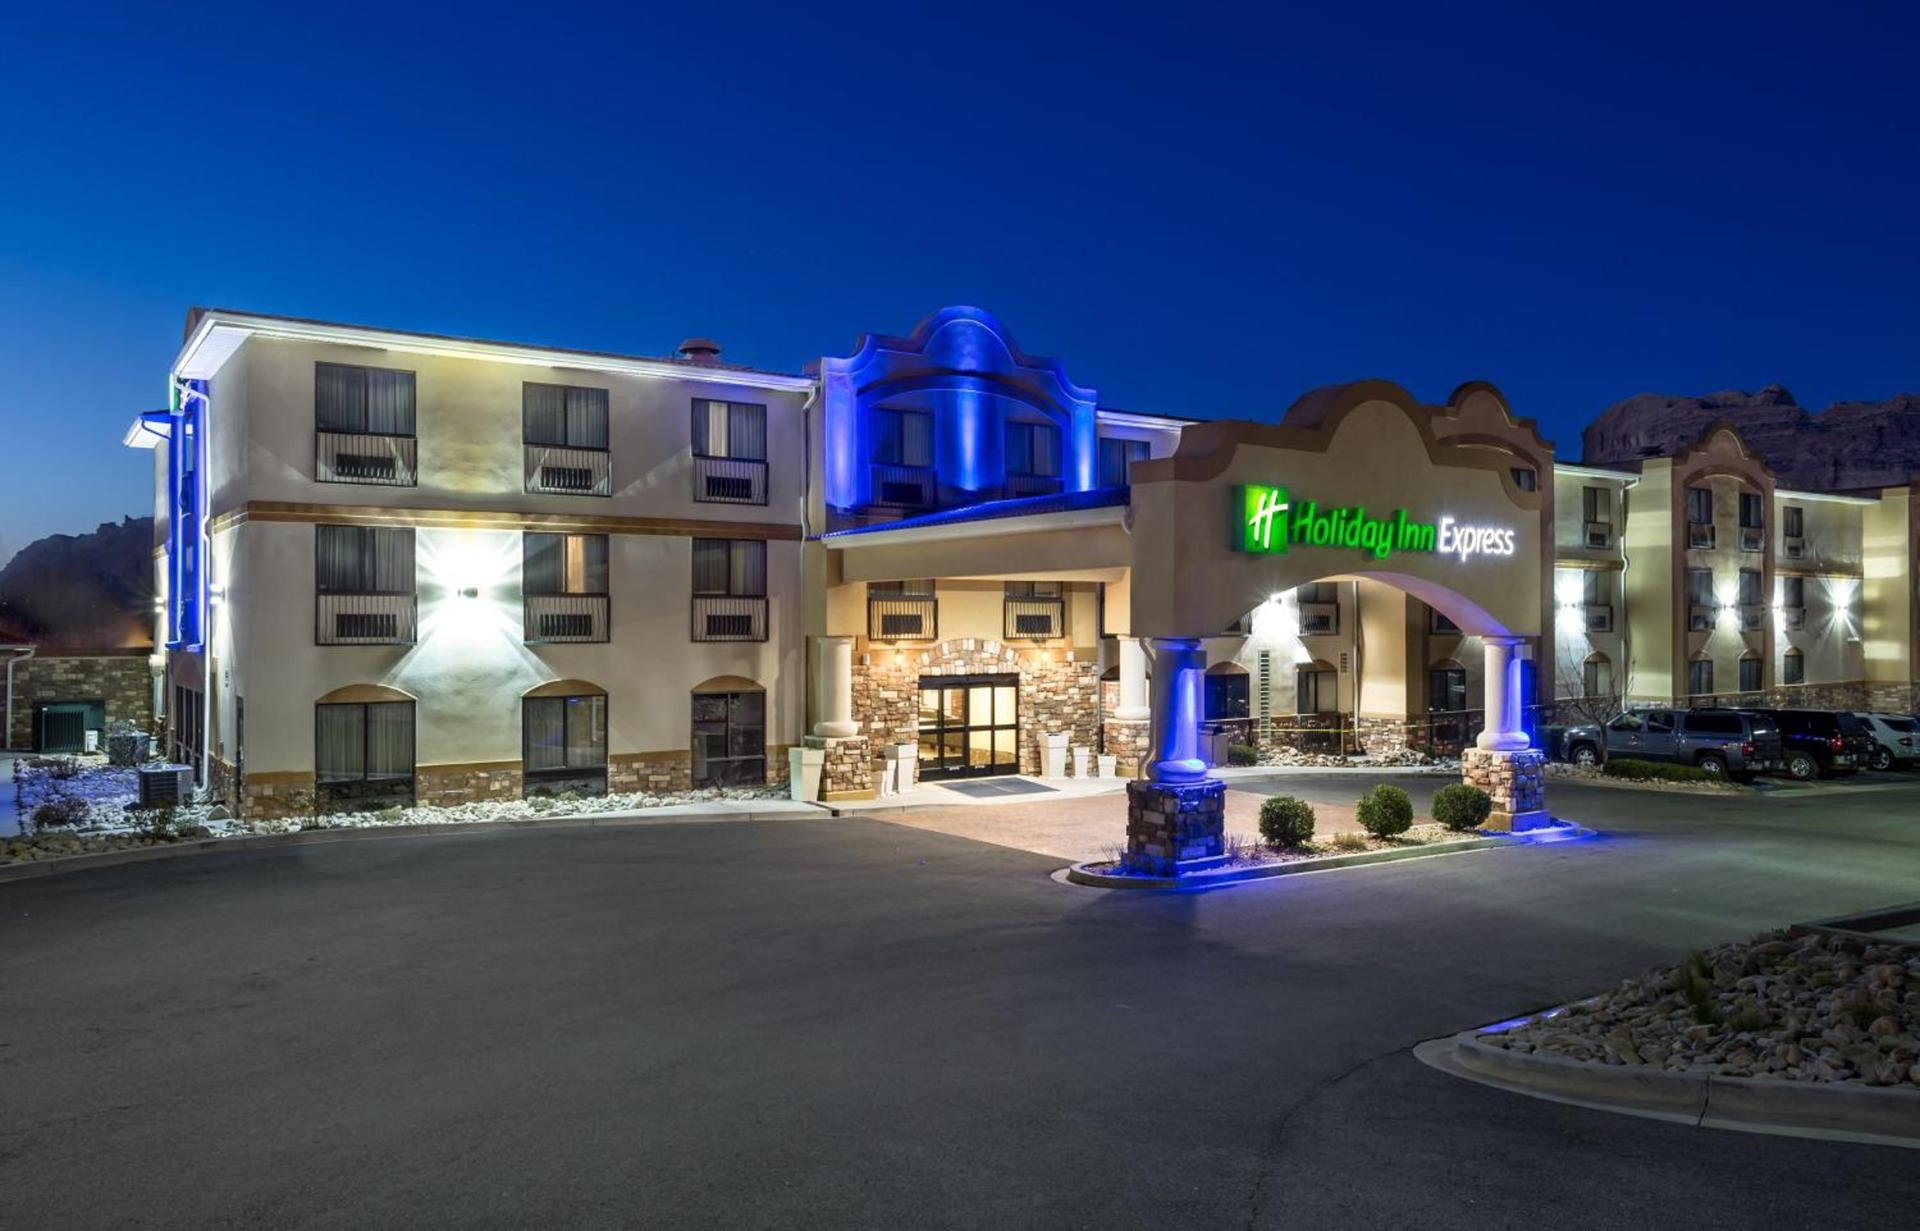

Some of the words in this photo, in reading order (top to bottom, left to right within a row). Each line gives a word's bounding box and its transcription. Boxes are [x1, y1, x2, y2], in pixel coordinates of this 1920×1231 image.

[1292, 501, 1394, 559] Holiday
[1397, 508, 1435, 551] Inn
[1438, 516, 1515, 562] Express
